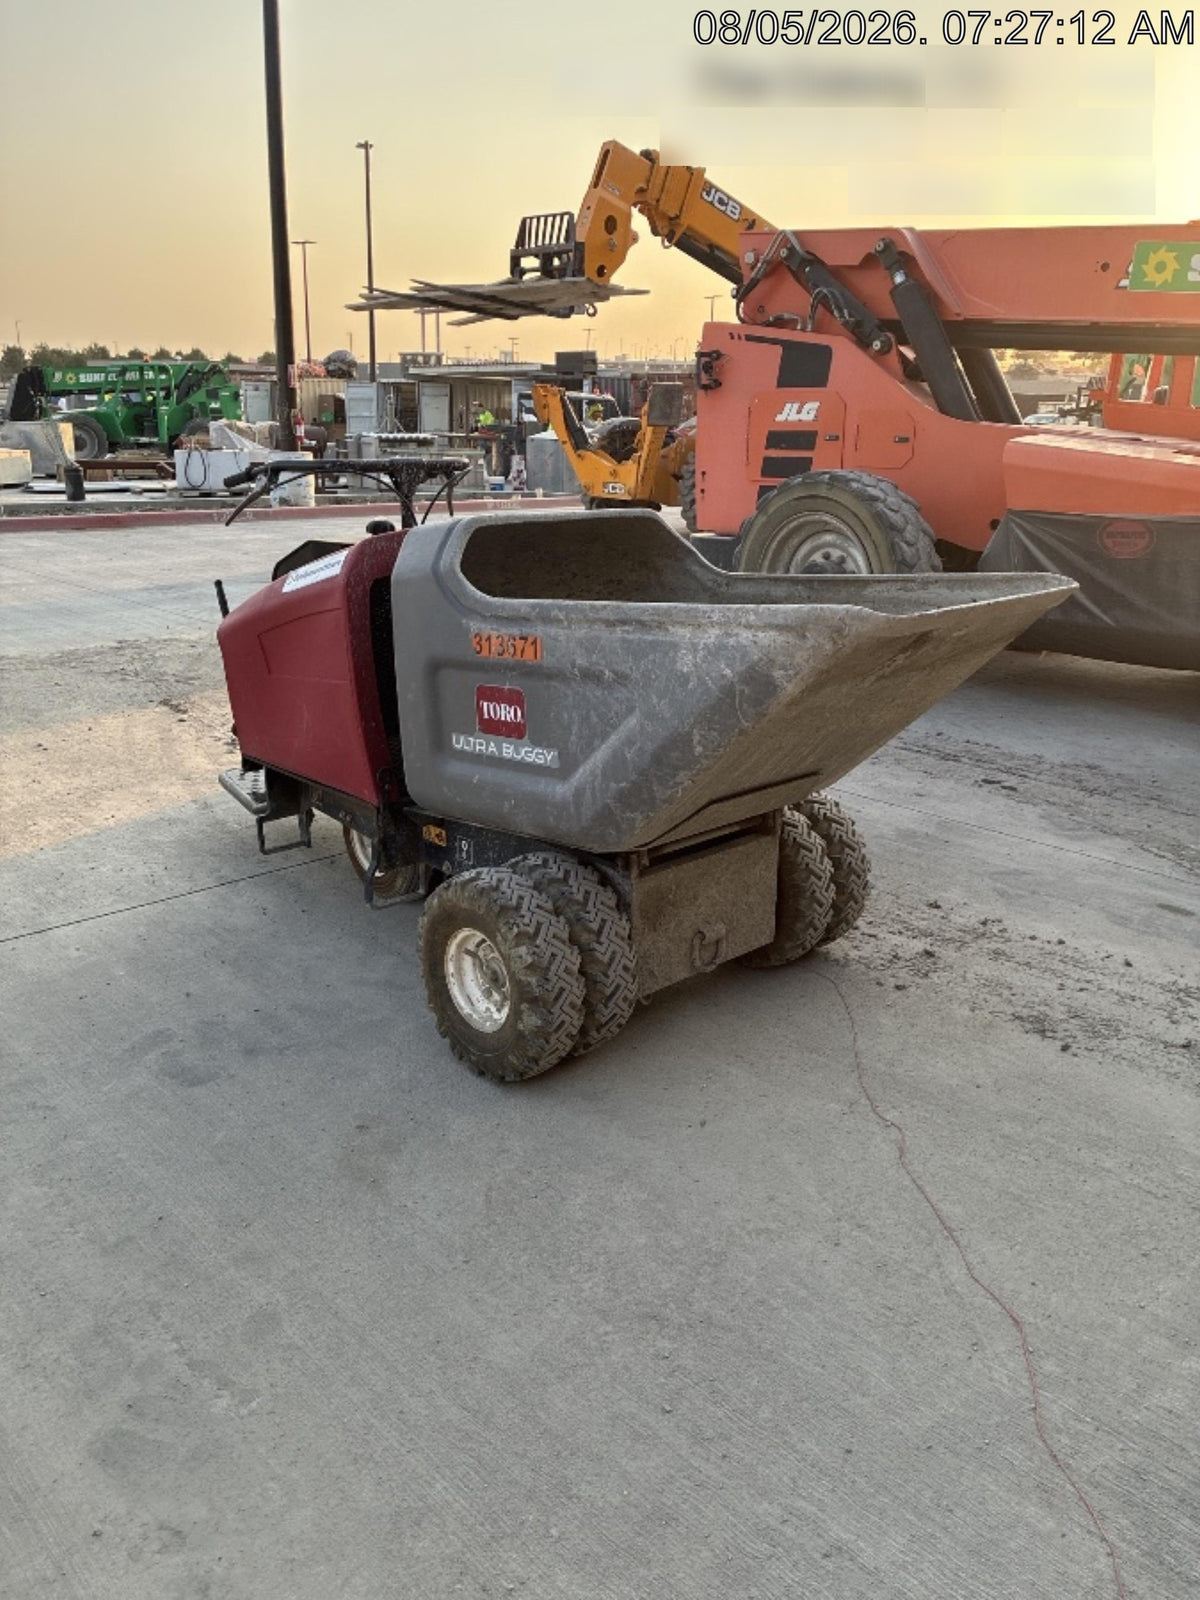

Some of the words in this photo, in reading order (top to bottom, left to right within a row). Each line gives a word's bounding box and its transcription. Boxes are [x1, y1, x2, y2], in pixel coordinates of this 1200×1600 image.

[701, 187, 741, 221] JCB
[774, 401, 821, 422] JLG
[473, 632, 539, 660] 313671
[480, 701, 522, 723] TORO
[452, 735, 499, 755] ULTRA
[502, 743, 555, 767] BUGGY
